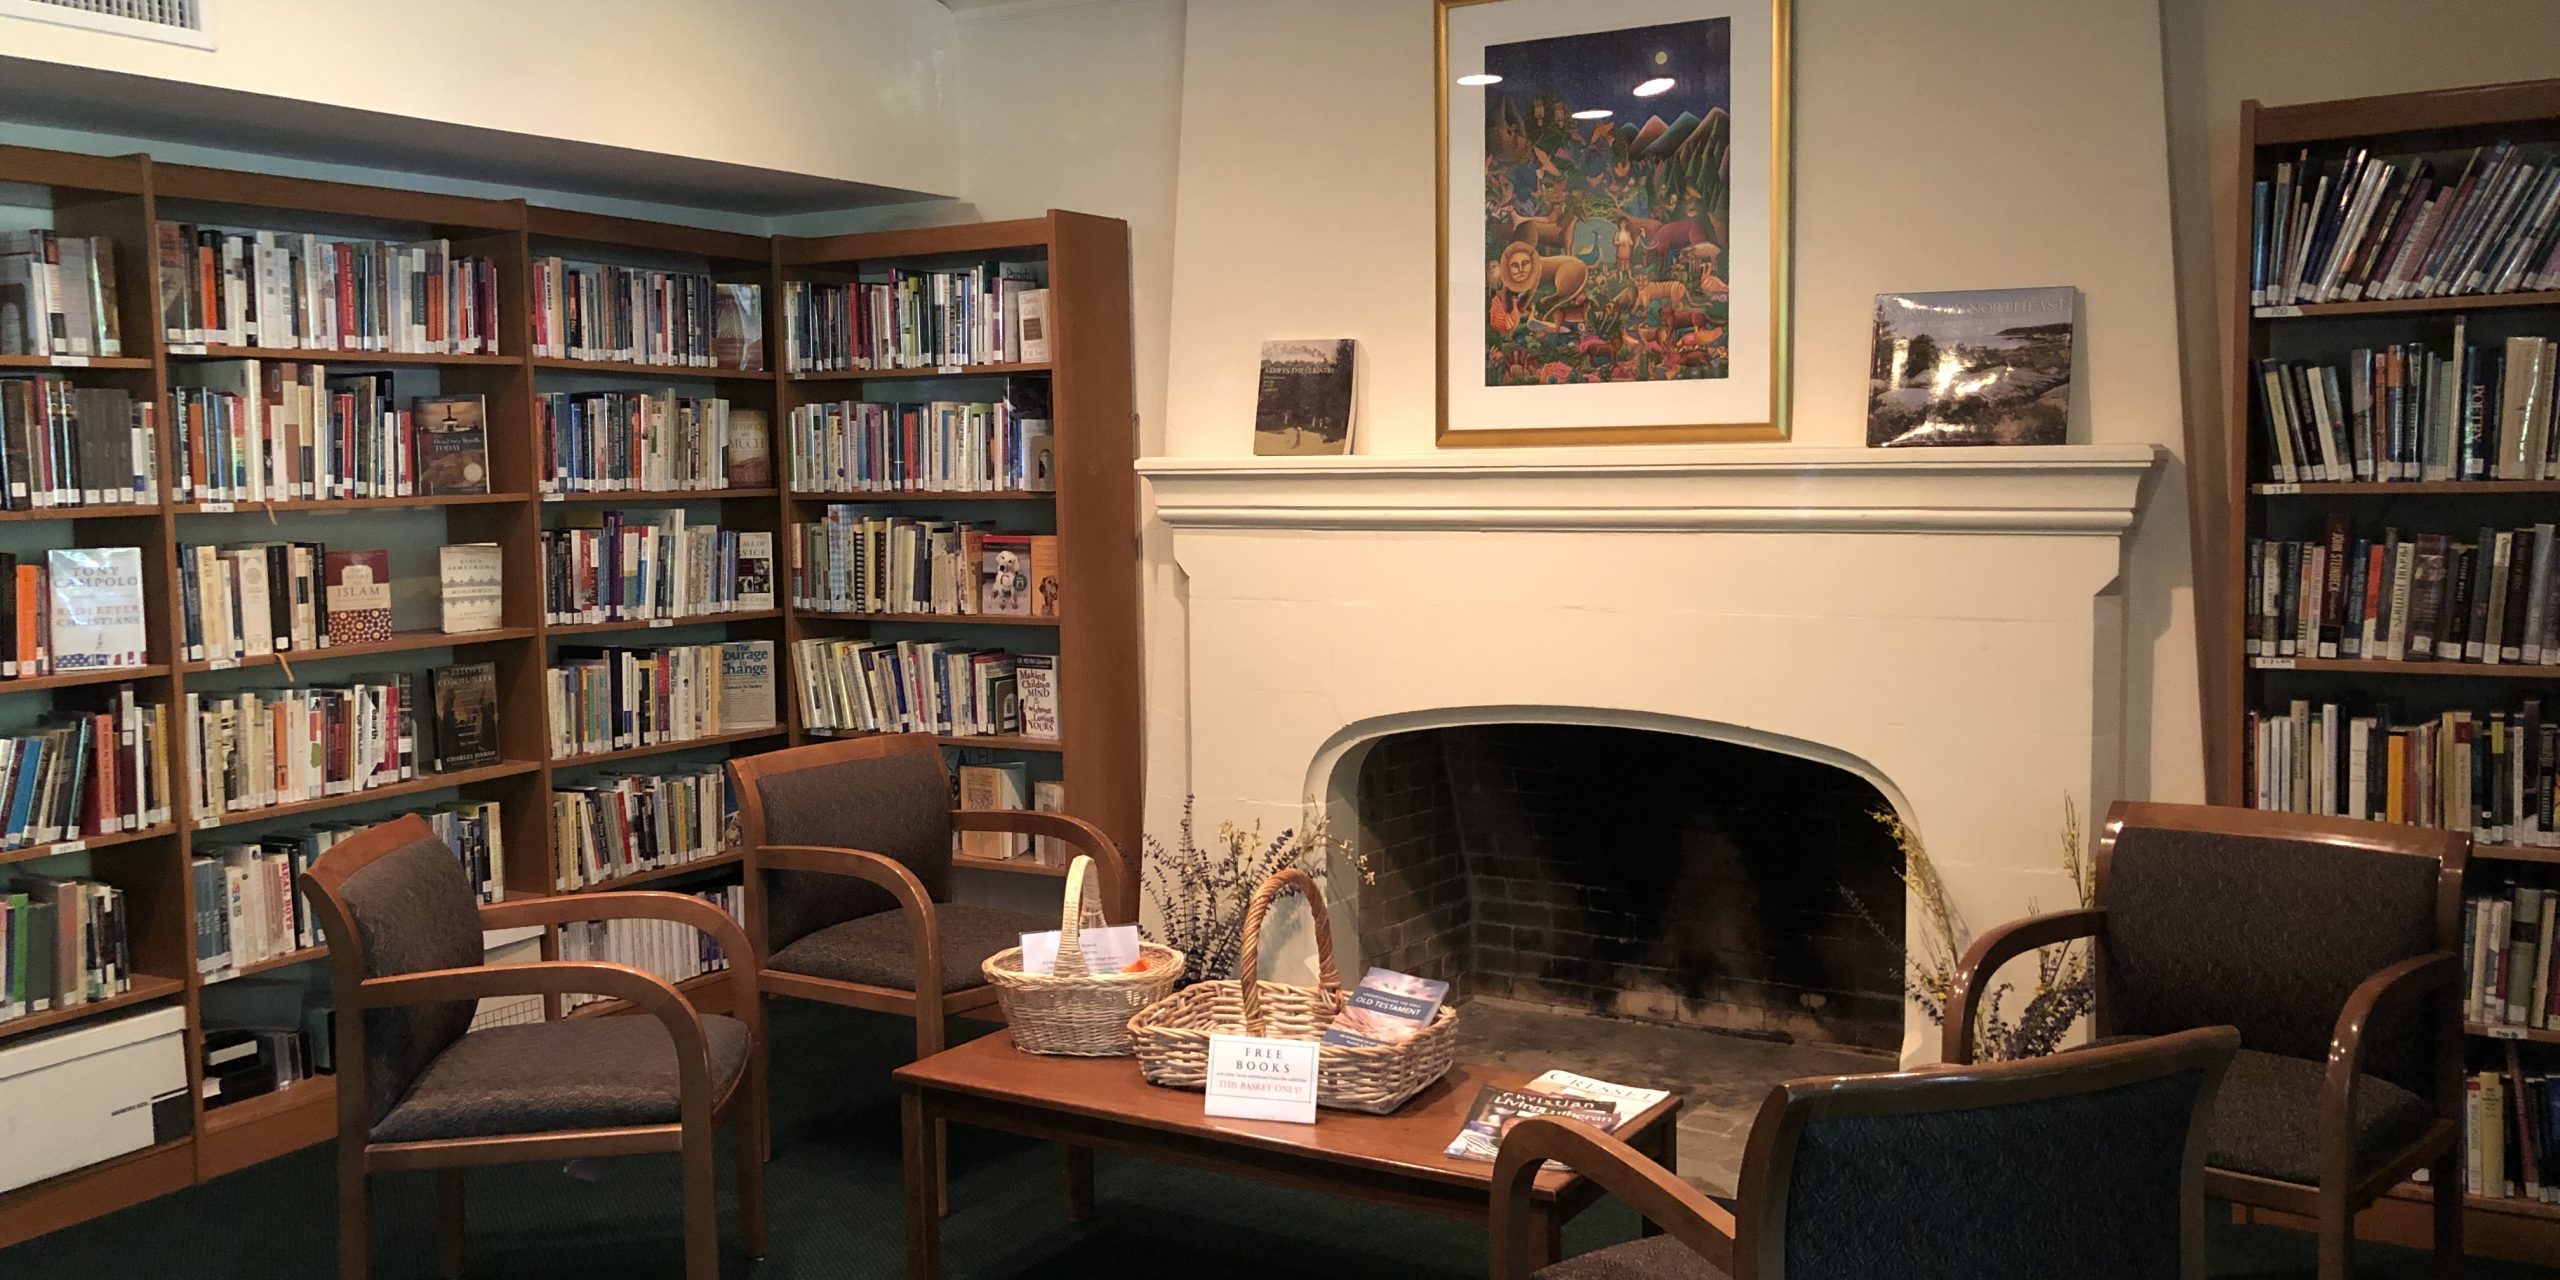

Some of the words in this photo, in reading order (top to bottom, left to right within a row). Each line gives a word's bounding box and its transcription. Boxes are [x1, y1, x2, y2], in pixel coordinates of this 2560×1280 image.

[2472, 384, 2485, 442] POETRY
[74, 566, 119, 577] TONY
[2328, 553, 2343, 592] STEINBECK
[54, 577, 138, 588] CAMPOLO
[337, 586, 380, 597] ISLAM
[723, 650, 769, 662] ourage
[437, 675, 492, 687] COMMUNITY
[1019, 670, 1046, 681] Making
[1022, 680, 1051, 689] Children
[1028, 688, 1050, 698] MIND
[1028, 720, 1054, 732] YOURS
[281, 862, 291, 896] REAL
[284, 899, 294, 930] BOYS
[1355, 996, 1373, 1006] OLD
[1375, 1000, 1422, 1016] TESTAMENT
[1244, 1047, 1284, 1060] FREE
[1236, 1060, 1290, 1074] BOOKS
[1219, 1080, 1238, 1089] THIS
[1240, 1082, 1272, 1092] BASKET
